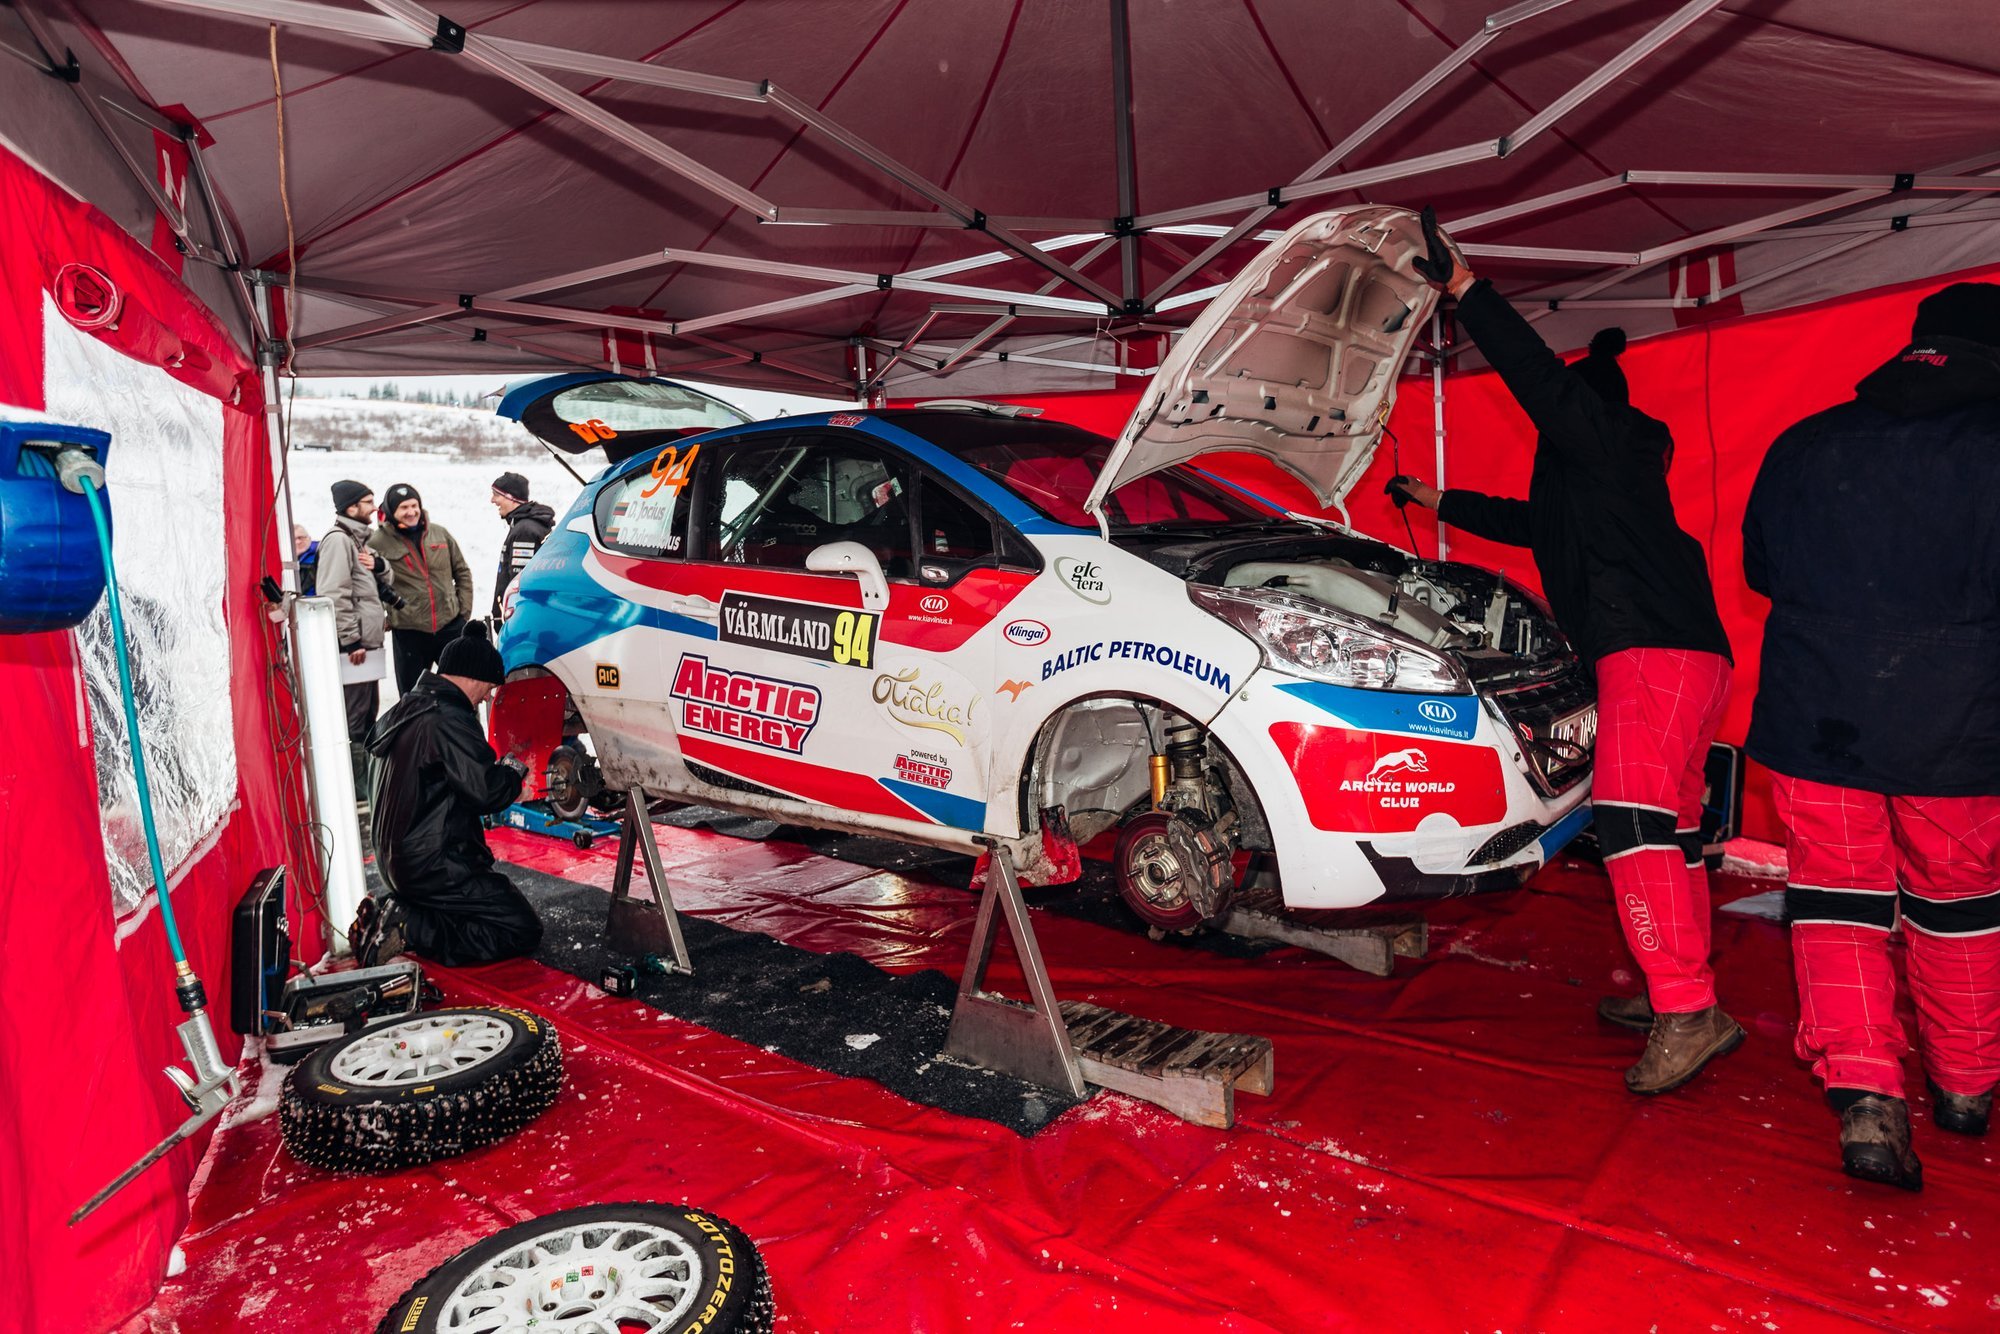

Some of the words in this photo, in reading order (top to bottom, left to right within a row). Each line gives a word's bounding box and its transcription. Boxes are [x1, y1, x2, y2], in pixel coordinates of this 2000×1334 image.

[640, 444, 700, 498] 94
[636, 501, 666, 521] Jocius
[924, 598, 943, 610] KIA
[908, 614, 953, 625] www.kiavilnius.lt
[724, 601, 831, 651] VÄRMLAND
[833, 611, 873, 667] 94
[1008, 625, 1045, 641] Klingai
[1041, 642, 1103, 681] BALTIC
[1108, 640, 1231, 694] PETROLEUM
[674, 658, 816, 722] ARCTIC
[1424, 703, 1451, 720] KIA
[685, 703, 806, 750] ENERGY
[1408, 723, 1469, 739] www.kiavilnius.lt
[910, 749, 937, 761] powered
[939, 754, 948, 766] by
[896, 756, 950, 779] ARCTIC
[900, 771, 947, 788] ENERGY
[1339, 780, 1402, 793] ARCTIC
[1405, 782, 1455, 793] WORLD
[1380, 797, 1420, 808] CLUB
[1625, 893, 1659, 951] OMP
[400, 1296, 429, 1332] PIRELLI
